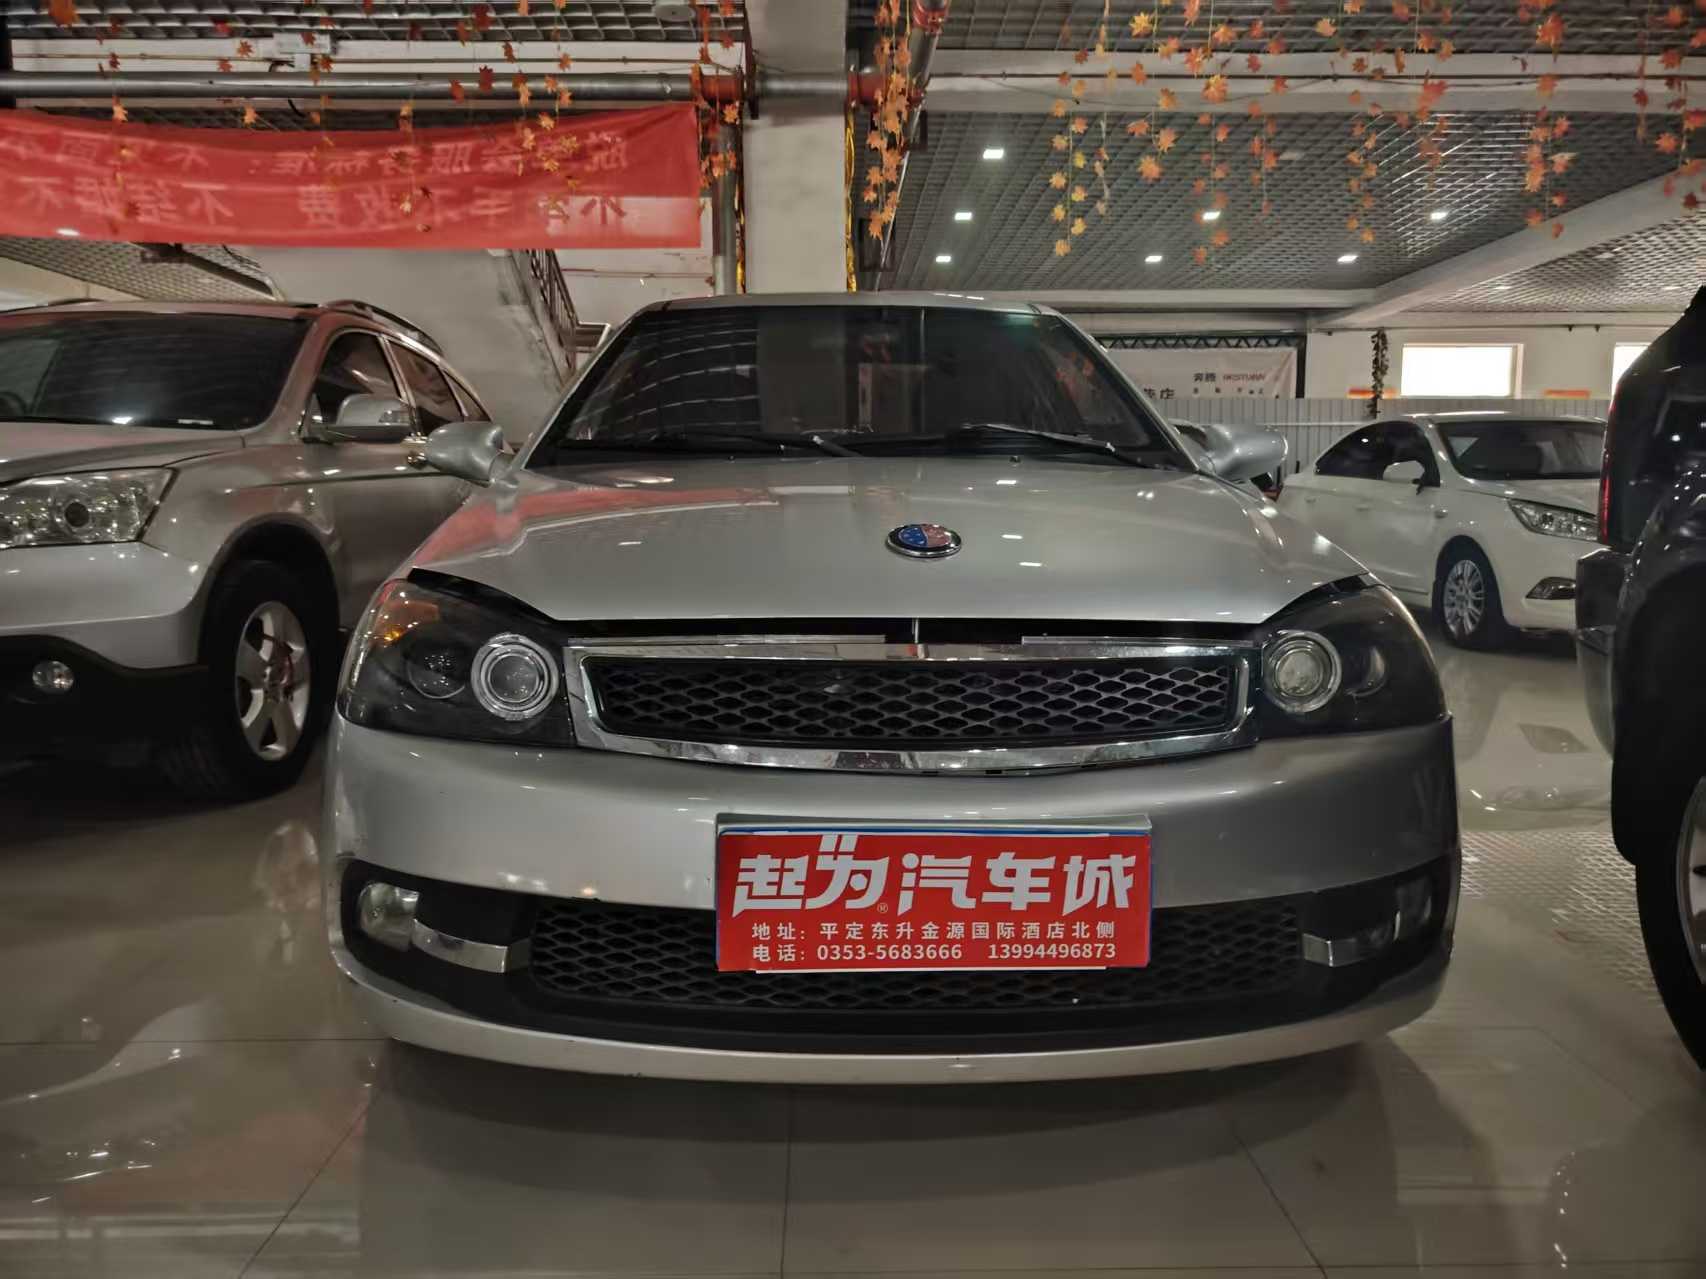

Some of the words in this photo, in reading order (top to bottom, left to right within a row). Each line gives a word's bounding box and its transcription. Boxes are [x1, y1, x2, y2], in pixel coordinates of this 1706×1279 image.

[820, 921, 1116, 940] 平定东升金源国际酒店北侧
[817, 944, 963, 961] 0353-5683666
[988, 943, 1117, 960] 13994496873
